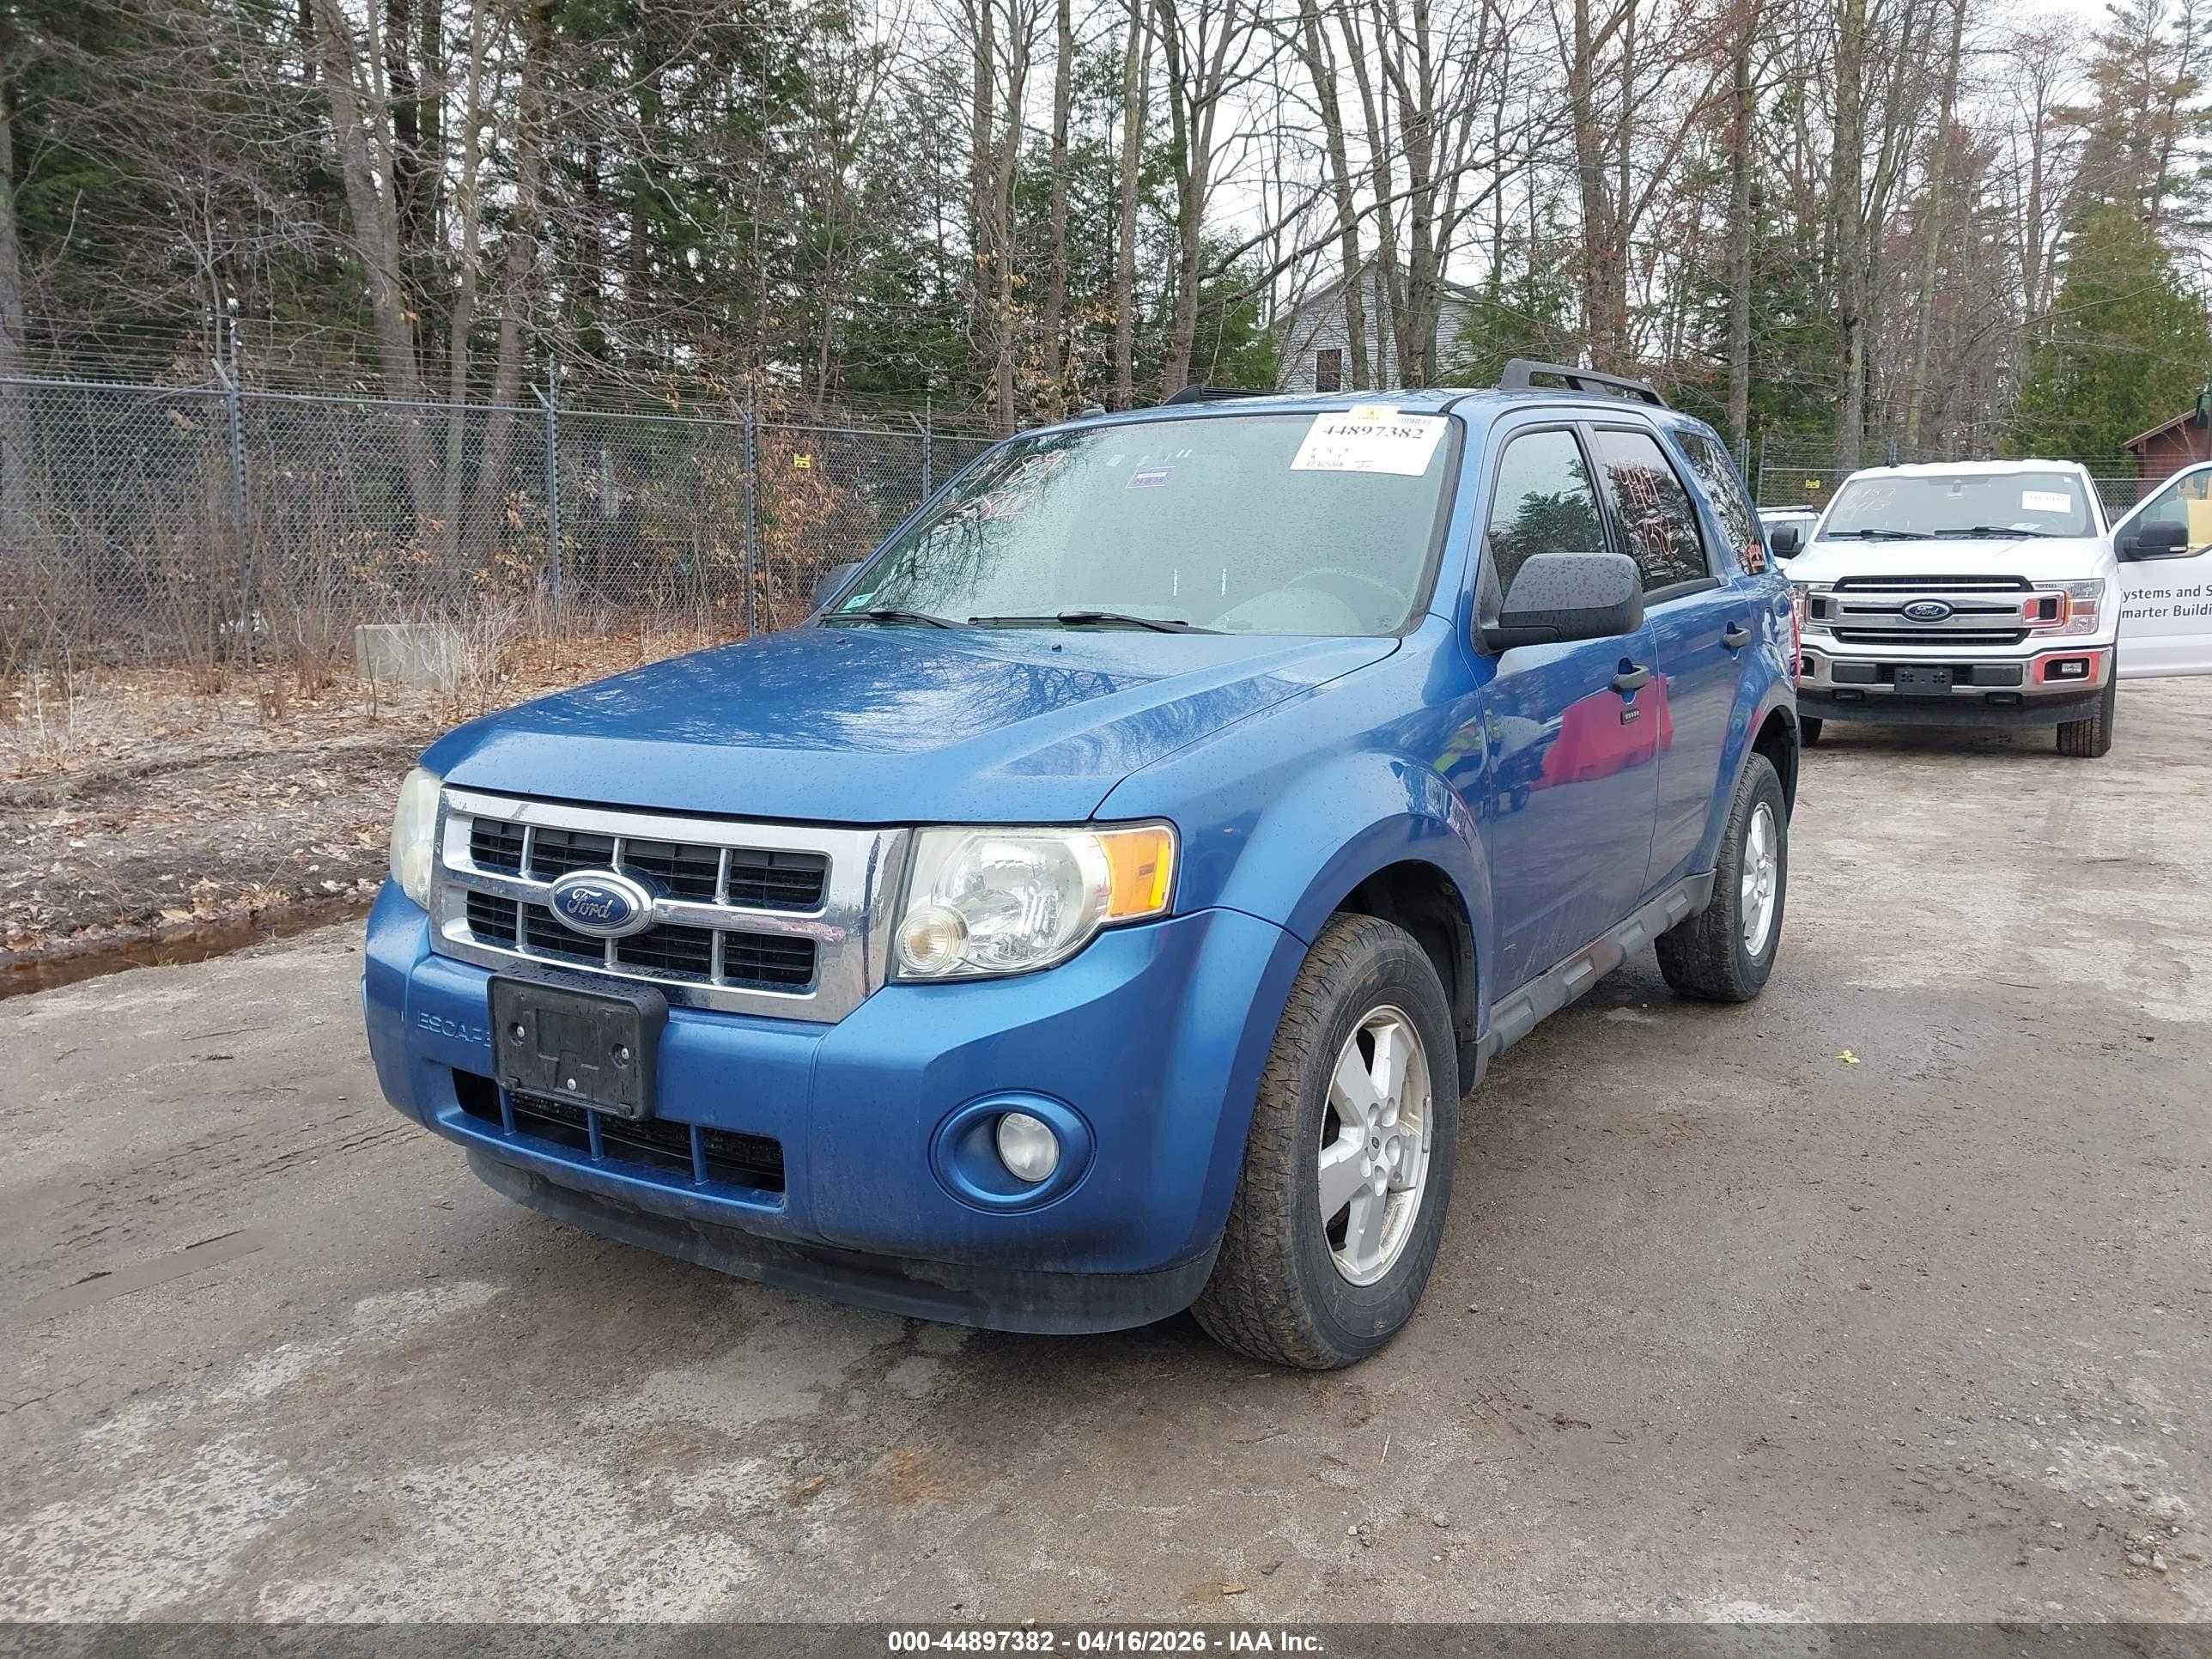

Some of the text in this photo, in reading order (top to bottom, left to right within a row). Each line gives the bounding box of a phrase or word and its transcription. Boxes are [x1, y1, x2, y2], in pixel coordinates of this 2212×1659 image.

[1322, 424, 1424, 439] 44897382
[2176, 585, 2201, 598] and
[1915, 605, 1939, 616] Ford
[568, 888, 614, 919] Ford
